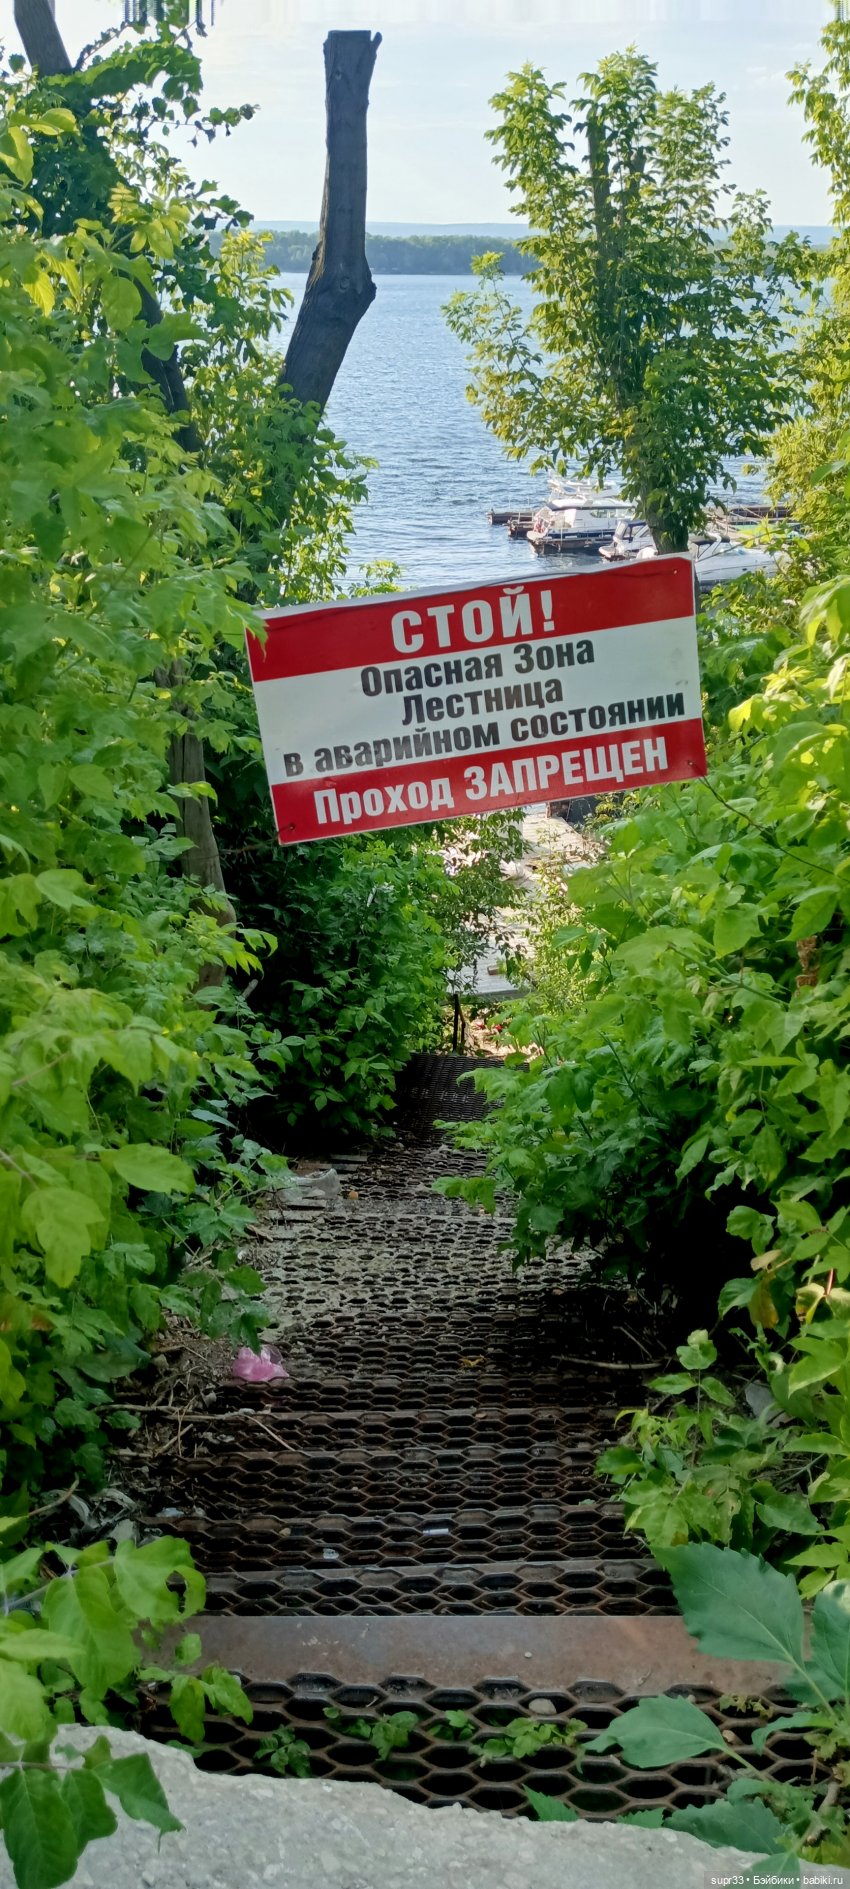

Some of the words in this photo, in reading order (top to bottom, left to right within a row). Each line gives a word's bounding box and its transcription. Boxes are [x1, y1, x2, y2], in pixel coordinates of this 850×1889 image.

[391, 585, 555, 654] СТОЙ!
[361, 650, 504, 697] Опасная
[514, 639, 595, 674] Зона
[402, 678, 564, 726] Лестница
[283, 752, 303, 777] в
[315, 722, 500, 773] аварийном
[510, 692, 685, 742] состоянии
[313, 777, 455, 825] Проход
[465, 736, 669, 801] ЗАПРЕЩЕН
